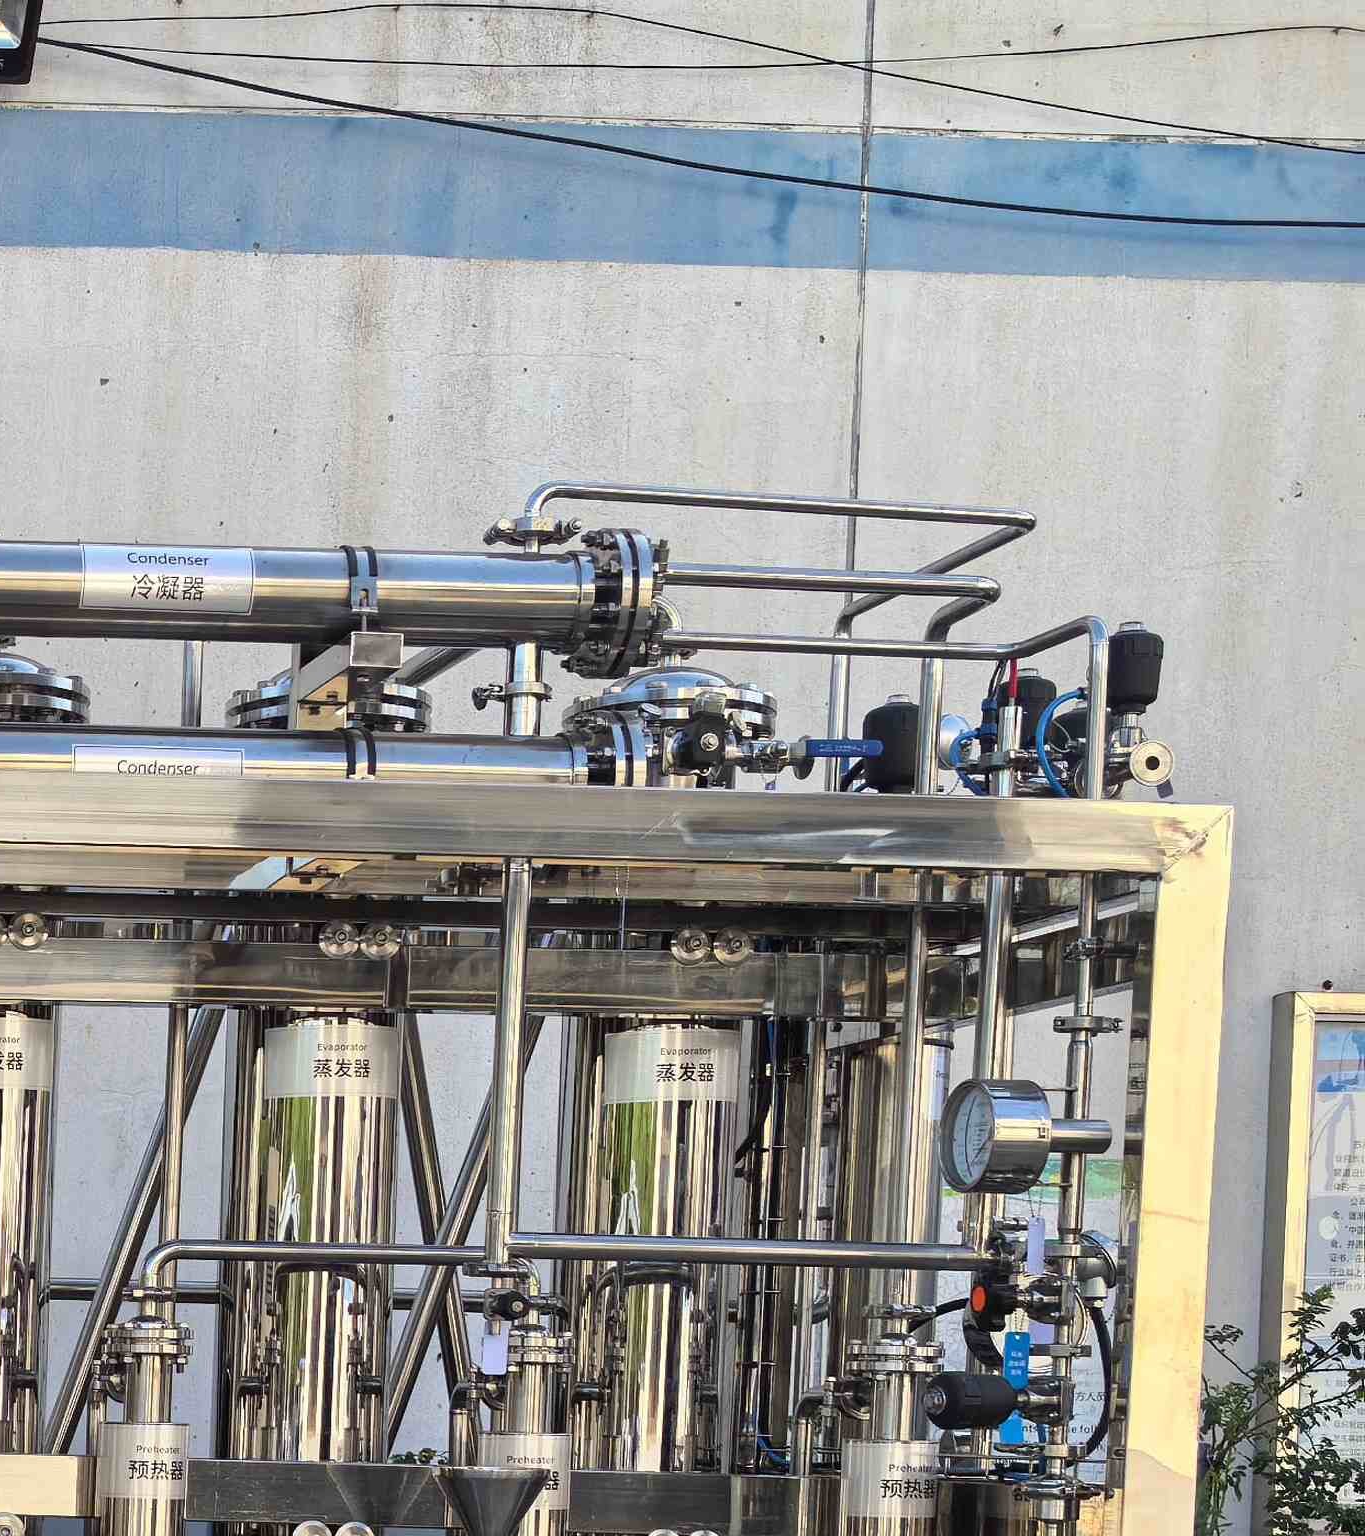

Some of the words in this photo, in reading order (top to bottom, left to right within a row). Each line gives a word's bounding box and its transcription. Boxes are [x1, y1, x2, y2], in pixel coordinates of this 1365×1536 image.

[127, 552, 209, 566] Condenser
[130, 574, 205, 601] 冷凝器
[117, 759, 199, 776] Condenser
[317, 1043, 368, 1053] Evaporator
[660, 1048, 712, 1058] Evaporator
[313, 1059, 371, 1078] 蒸发器
[656, 1063, 714, 1082] 蒸发器
[128, 1459, 184, 1480] 预热器
